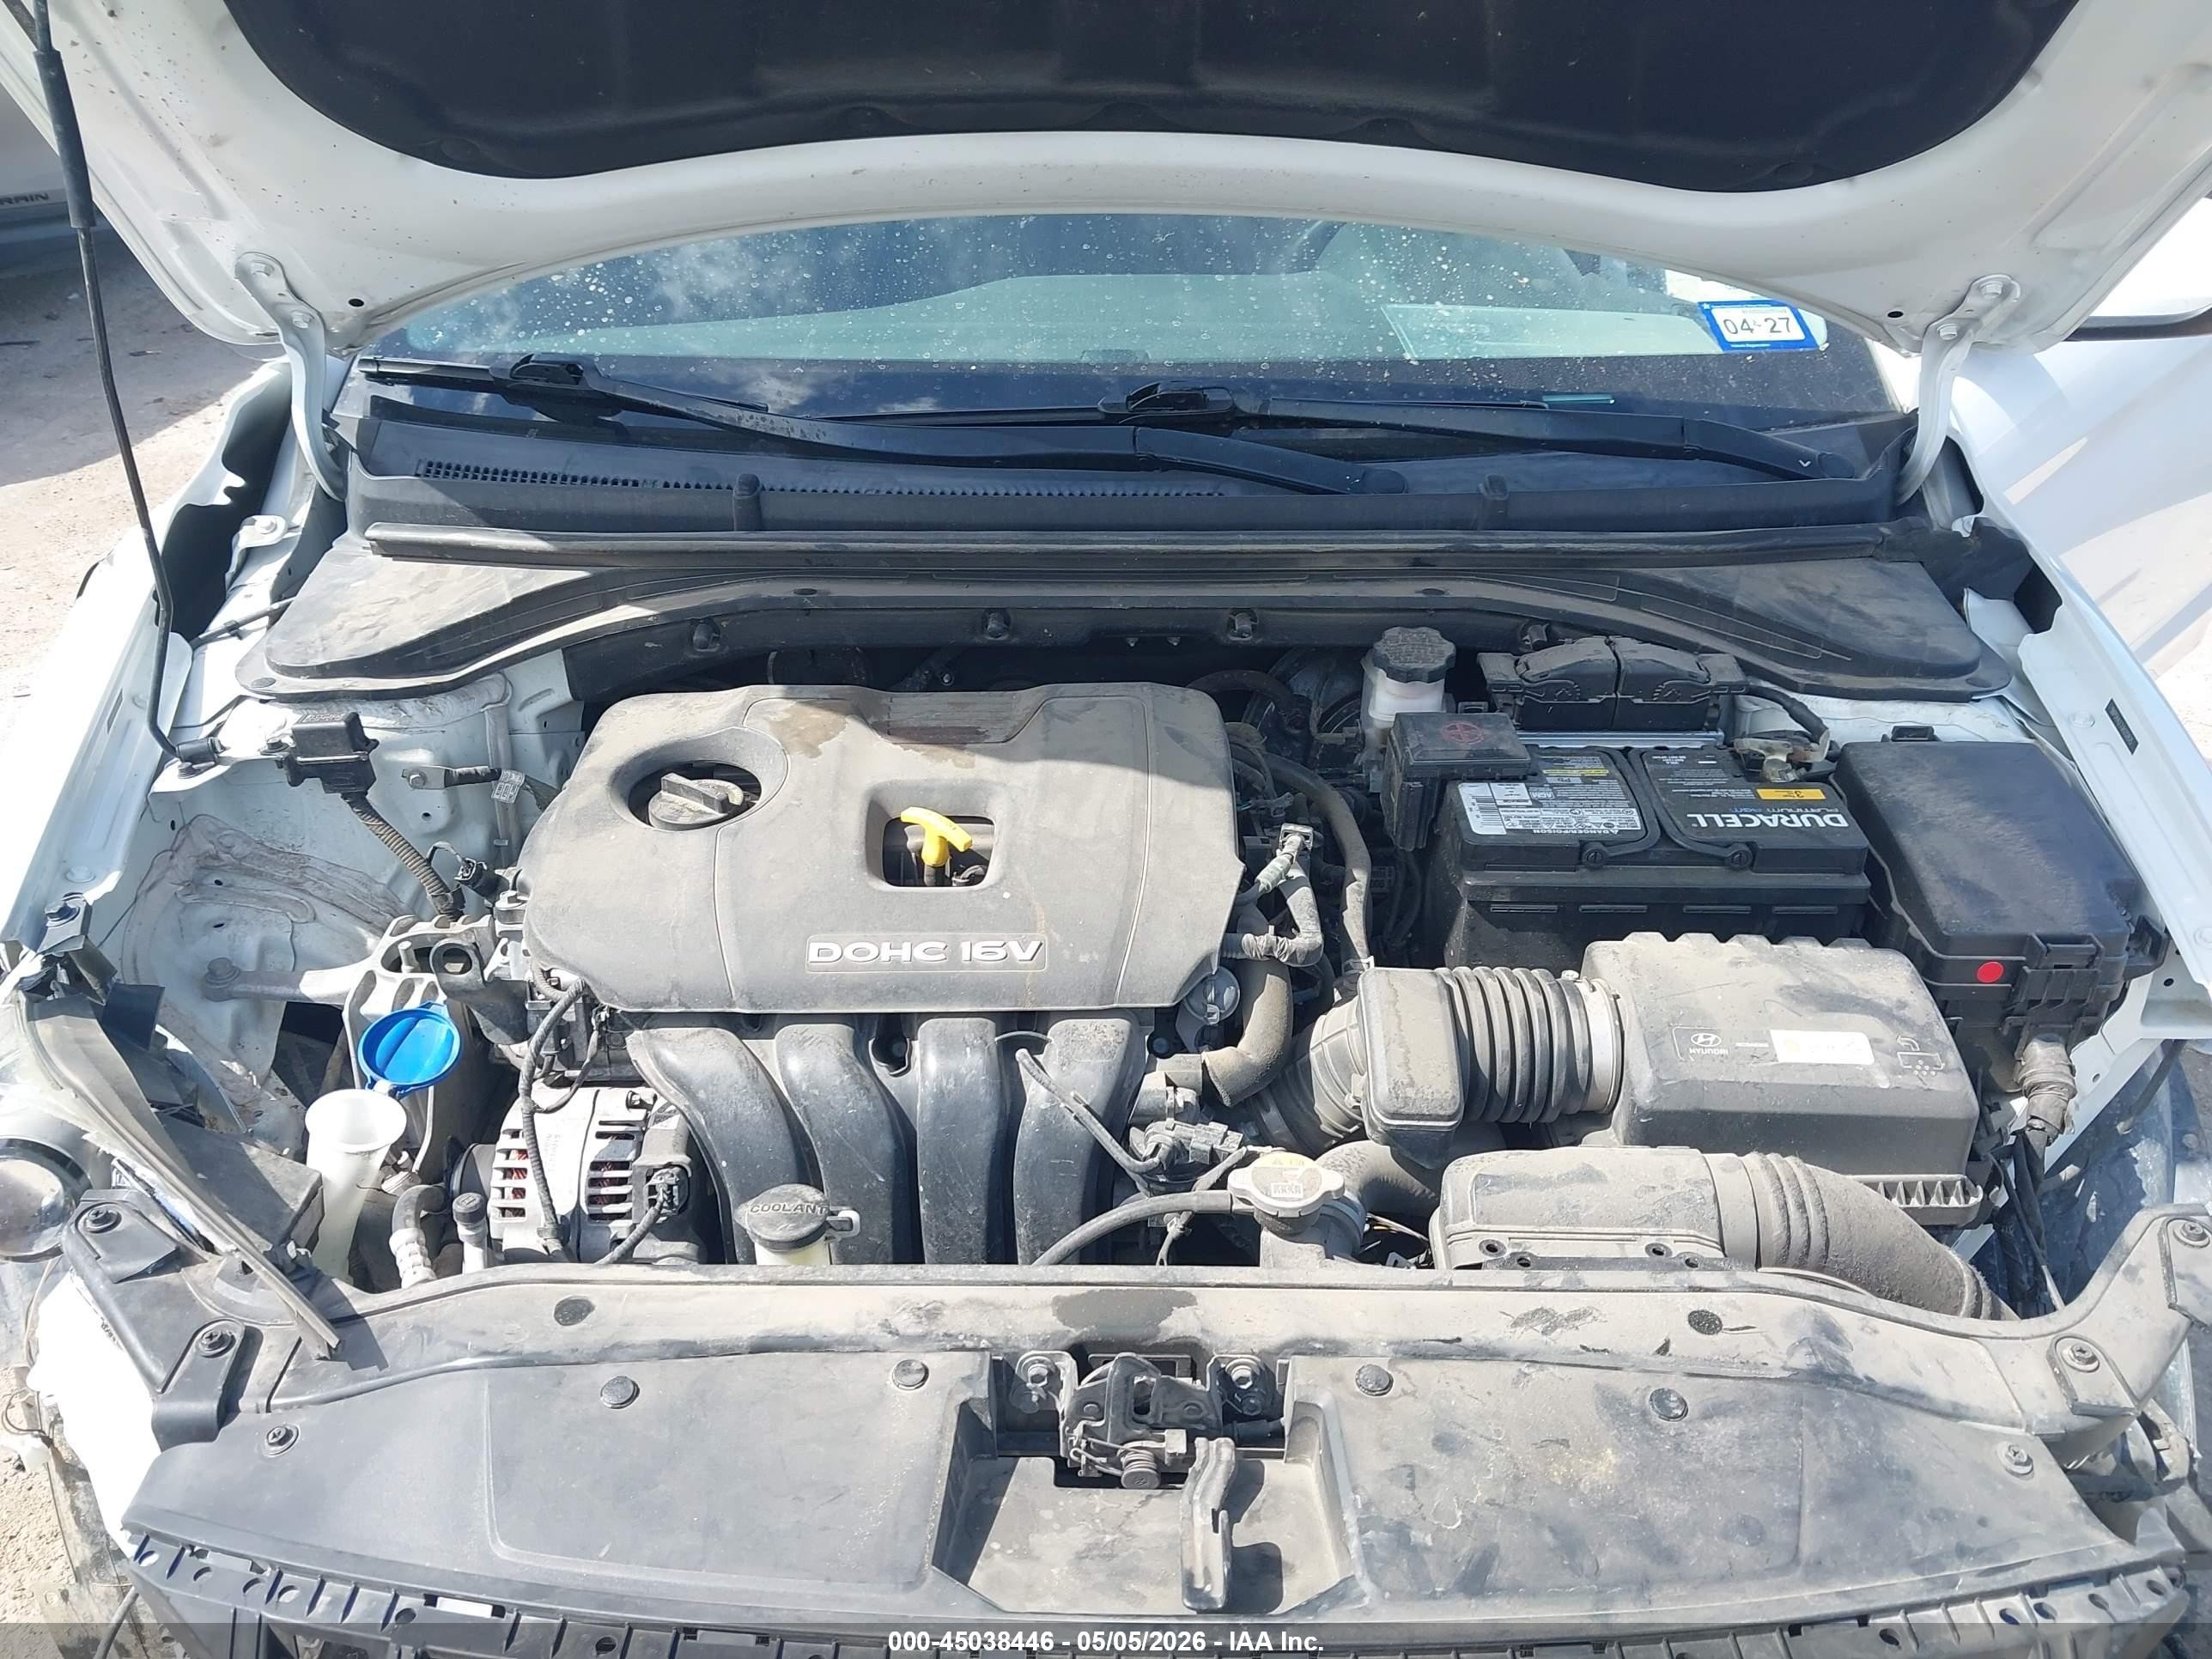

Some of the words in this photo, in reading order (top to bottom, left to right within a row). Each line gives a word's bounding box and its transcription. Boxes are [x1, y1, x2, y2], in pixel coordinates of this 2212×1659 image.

[1723, 319, 1754, 334] 04
[1764, 318, 1790, 333] 27
[1686, 813, 1850, 828] DURACELL
[808, 941, 948, 963] DOHC
[961, 940, 1045, 963] 16V
[750, 1203, 827, 1214] COOLANT
